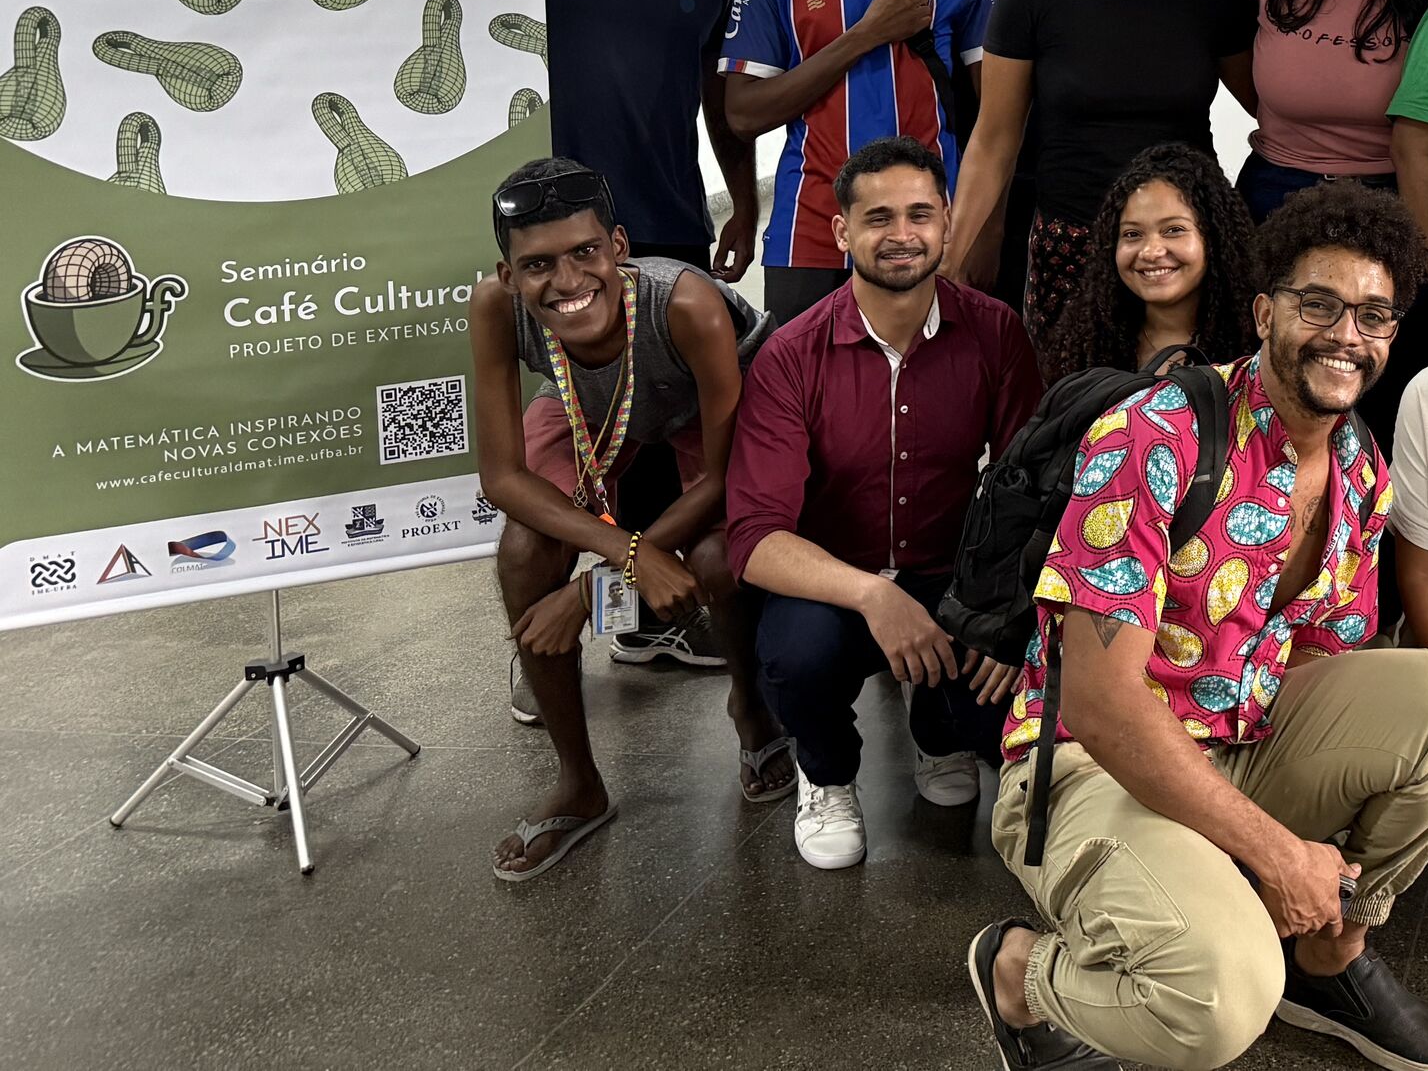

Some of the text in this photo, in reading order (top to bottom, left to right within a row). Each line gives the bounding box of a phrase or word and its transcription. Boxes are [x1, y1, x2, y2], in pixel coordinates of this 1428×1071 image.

[221, 253, 367, 283] Seminário
[223, 291, 319, 328] Café
[229, 317, 469, 359] PROJETO DE EXTENSÃO
[52, 406, 361, 458] A MATEMÁTICA INSPIRANDO
[164, 424, 363, 463] NOVAS CONEXÕES
[95, 445, 364, 490] www.cafeculturaldmat.ime.ufba.br
[401, 520, 461, 539] PROEXT
[31, 584, 77, 595] IME-UFBA
